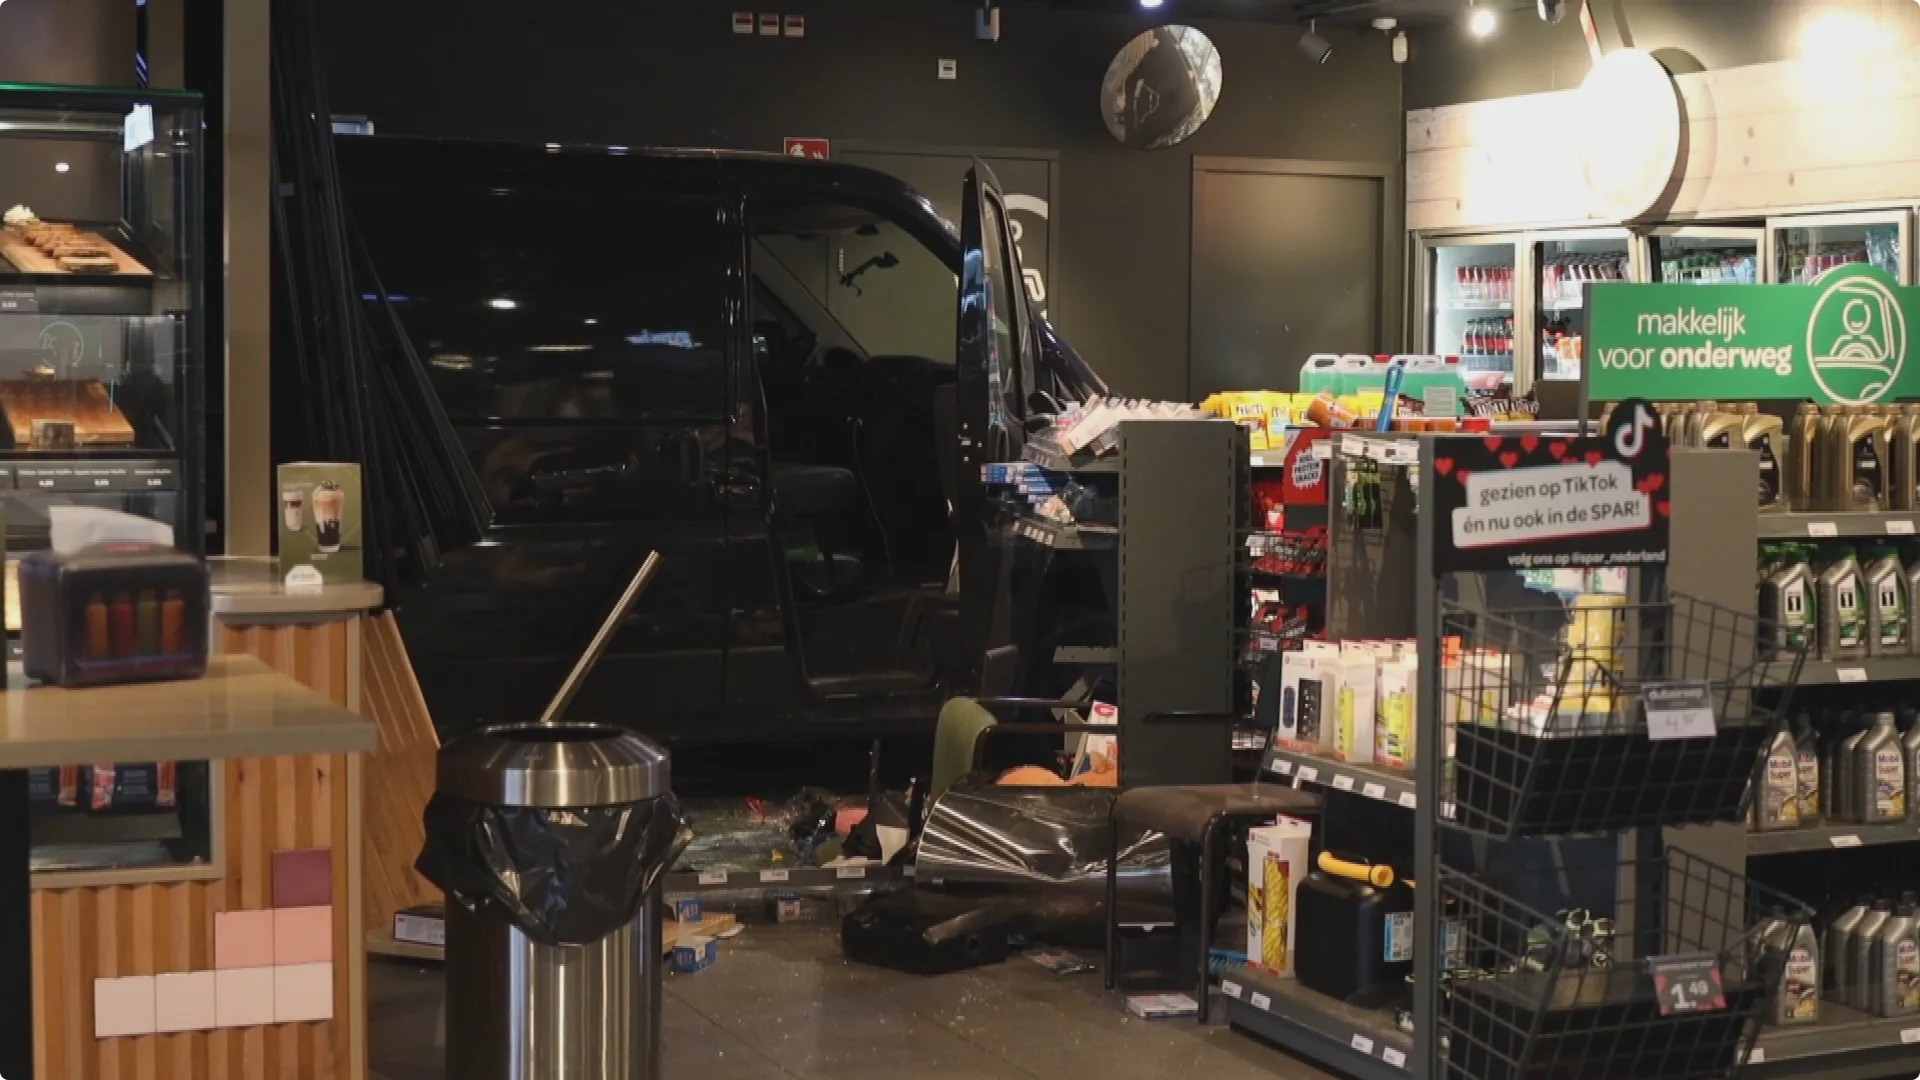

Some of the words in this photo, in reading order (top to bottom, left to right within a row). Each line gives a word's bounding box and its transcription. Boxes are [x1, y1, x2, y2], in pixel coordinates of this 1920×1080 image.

[1637, 306, 1746, 342] makkelijk
[1598, 348, 1656, 369] voor
[1659, 339, 1793, 376] onderweg
[1480, 482, 1536, 507] gezien
[1539, 483, 1561, 499] op
[1563, 473, 1617, 494] TikTok
[1463, 515, 1485, 534] én
[1488, 516, 1510, 531] nu
[1513, 510, 1544, 529] ook
[1548, 506, 1564, 525] in
[1566, 506, 1588, 523] de
[1591, 499, 1641, 520] SPAR!
[1507, 552, 1532, 568] volg
[1533, 554, 1553, 565] ons
[1554, 553, 1570, 567] op
